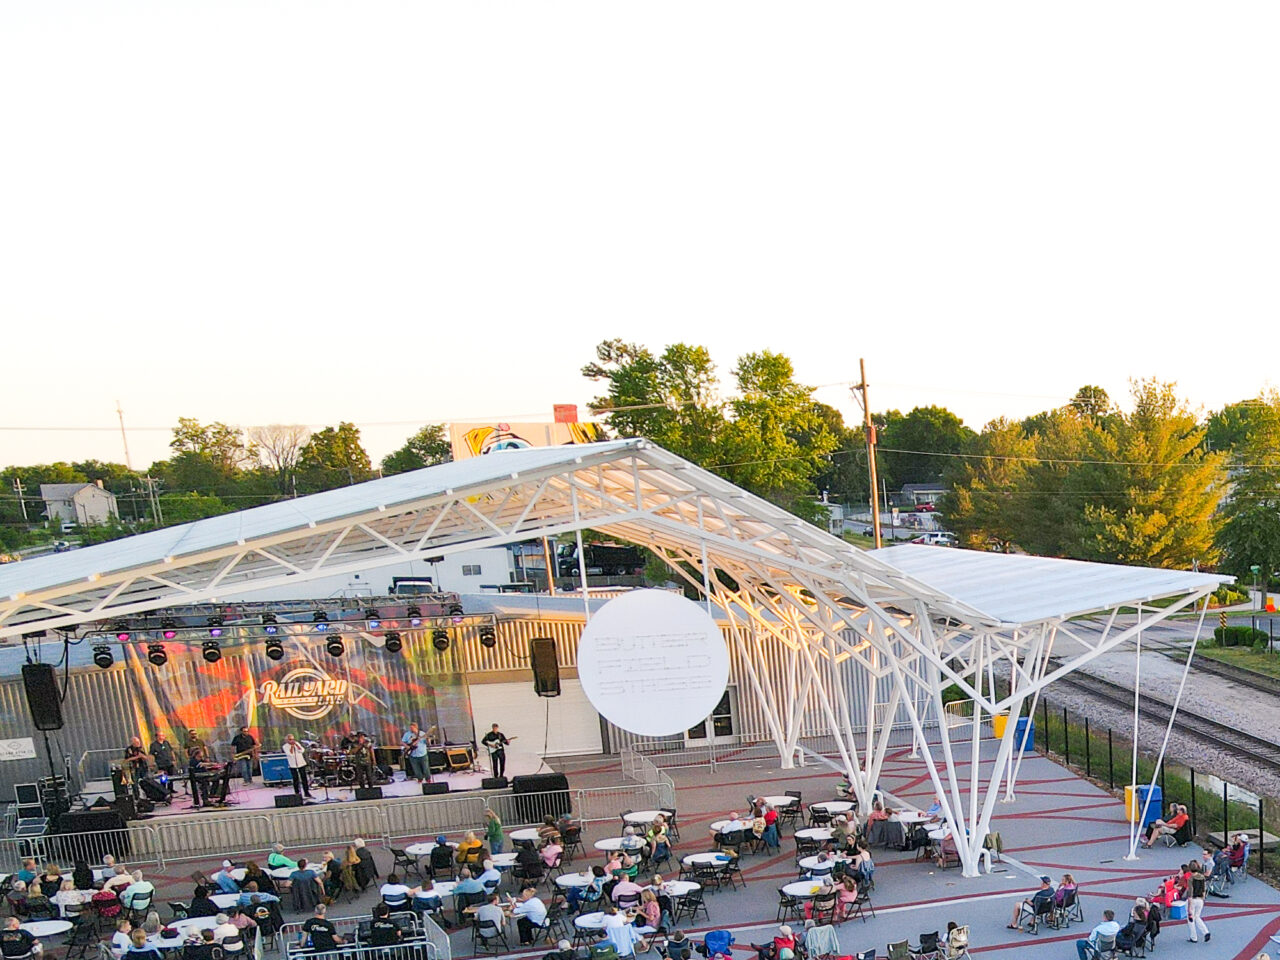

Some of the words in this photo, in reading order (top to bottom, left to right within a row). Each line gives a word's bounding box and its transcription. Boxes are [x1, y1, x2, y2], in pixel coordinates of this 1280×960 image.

[597, 654, 711, 675] FIELD
[597, 675, 712, 696] STAGE
[317, 695, 345, 706] LIVE
